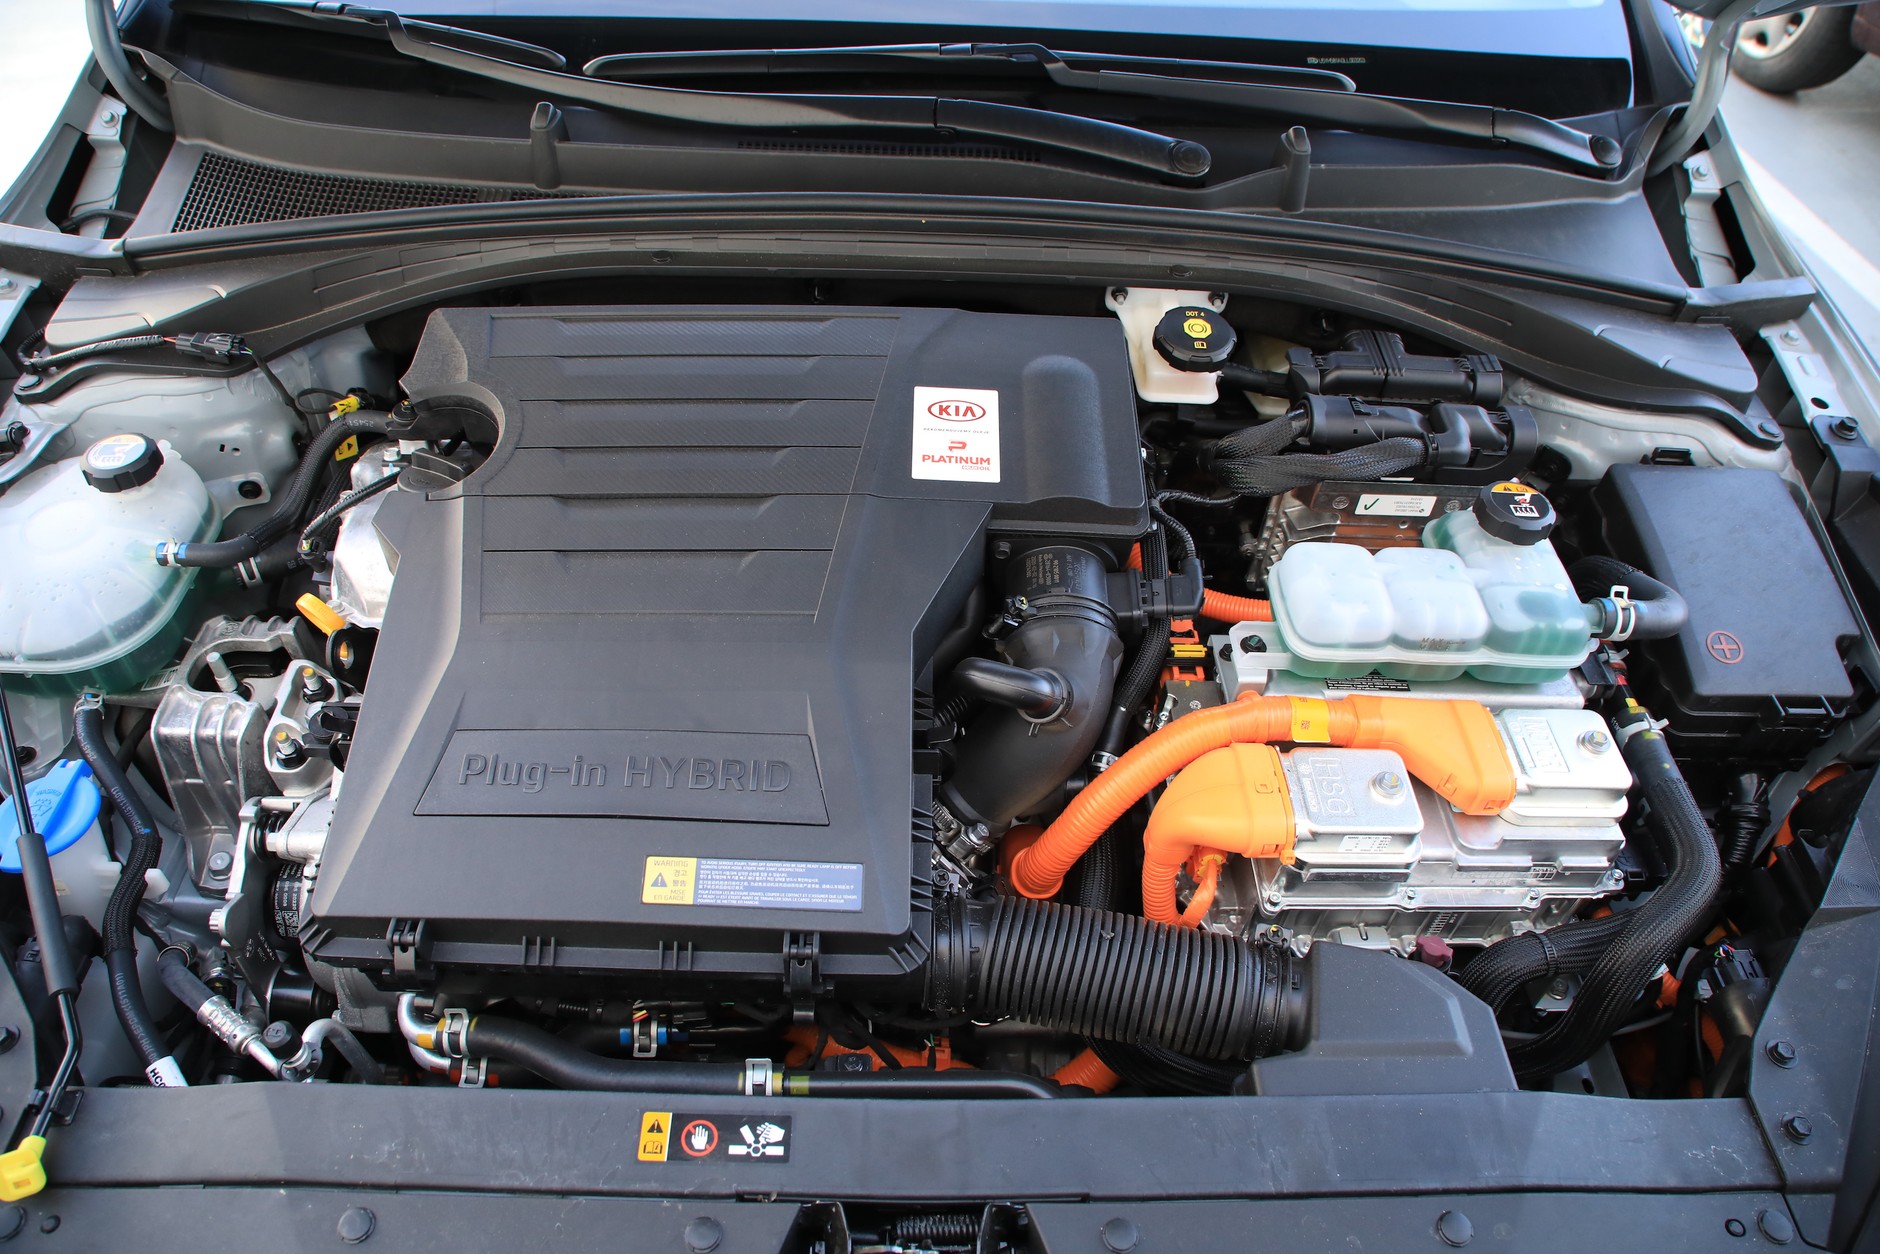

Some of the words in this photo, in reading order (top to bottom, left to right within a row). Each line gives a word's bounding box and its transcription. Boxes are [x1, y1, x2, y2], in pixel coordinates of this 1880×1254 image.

[938, 404, 976, 417] KIA
[922, 454, 990, 465] PLATINUM
[458, 752, 607, 793] Plug-in
[624, 755, 792, 792] HYBRID
[1314, 764, 1350, 814] HSG
